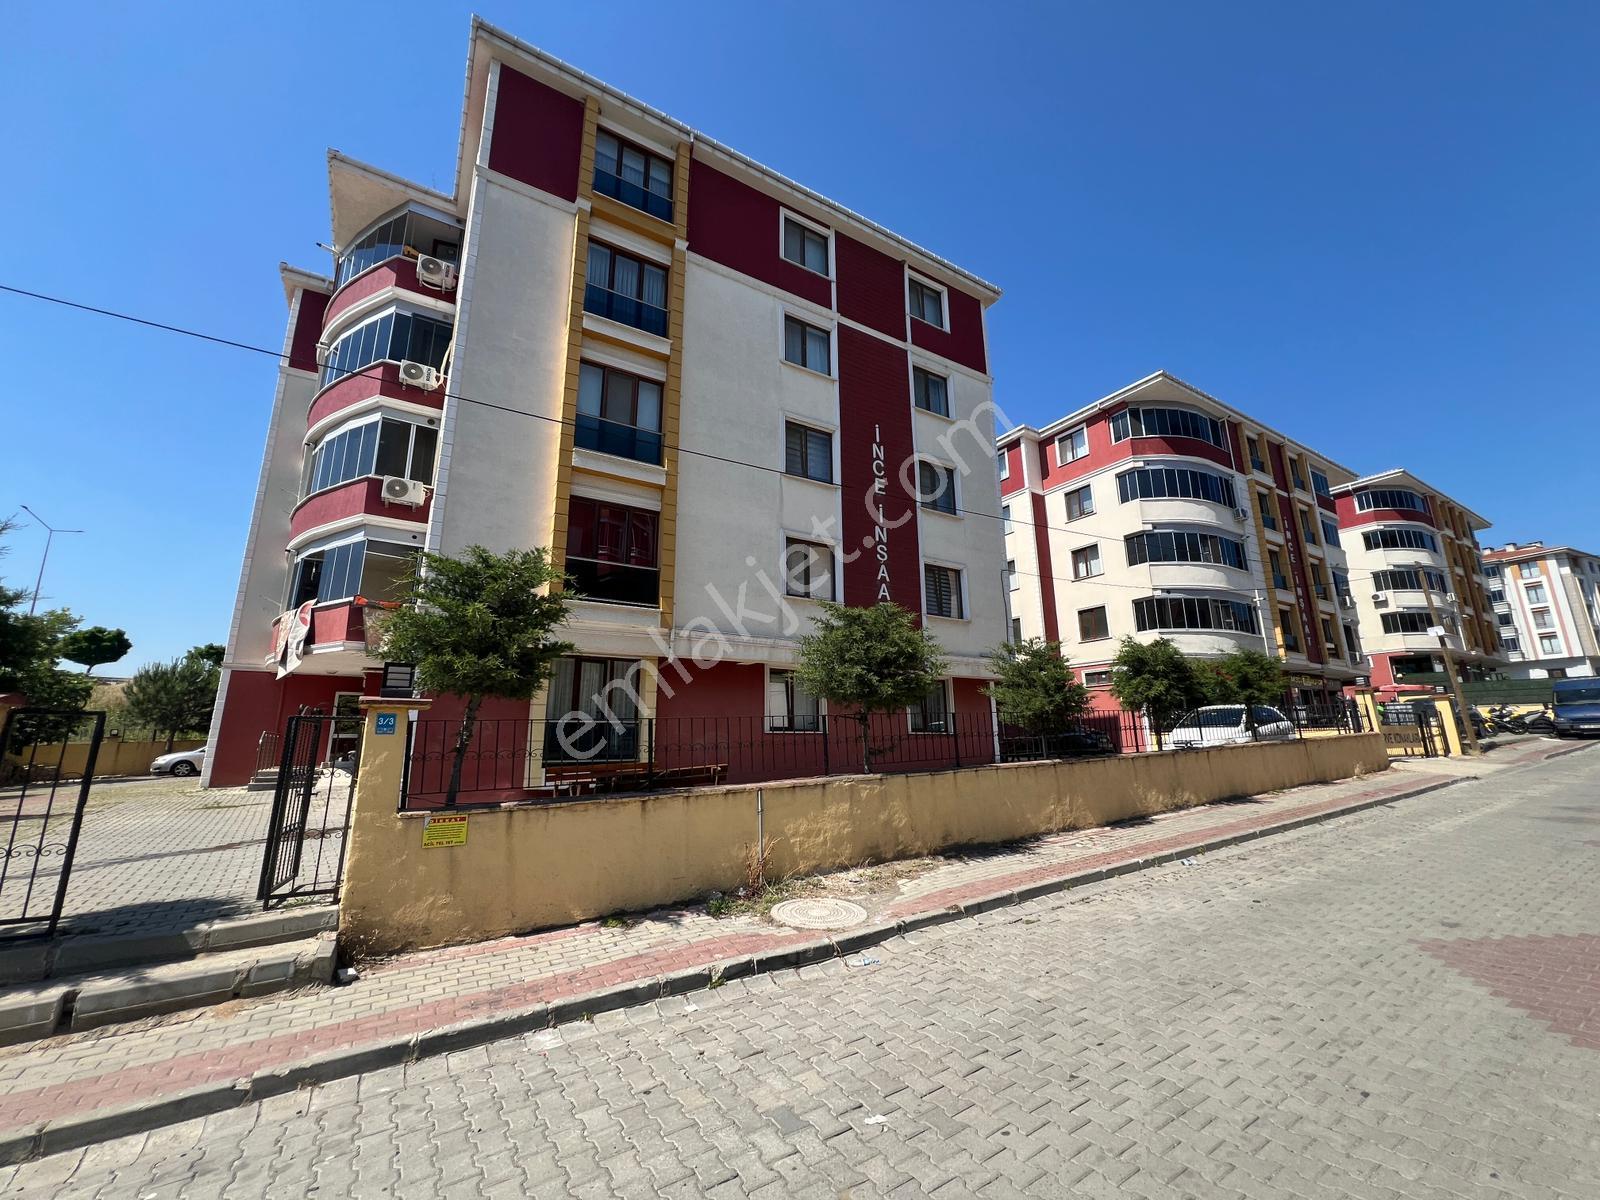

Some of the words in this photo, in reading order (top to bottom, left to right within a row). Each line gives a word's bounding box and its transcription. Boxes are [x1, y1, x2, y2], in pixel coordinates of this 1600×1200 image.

[872, 424, 887, 495] İNCE
[874, 503, 891, 604] İNŞAA
[378, 717, 394, 725] 3/3
